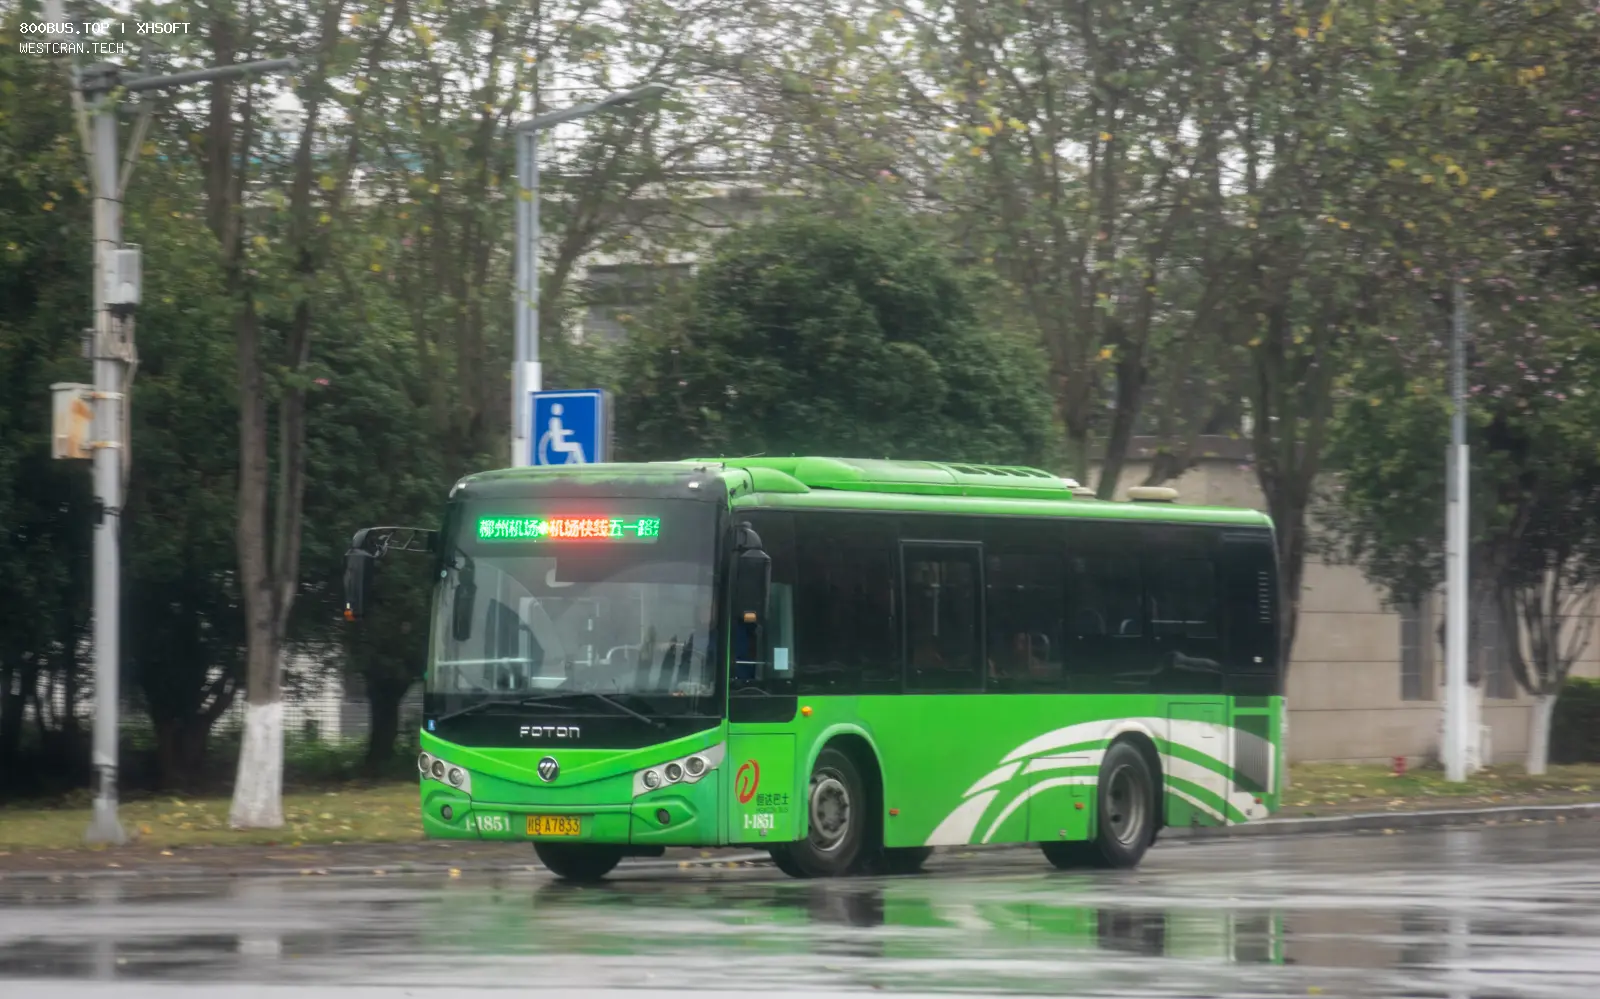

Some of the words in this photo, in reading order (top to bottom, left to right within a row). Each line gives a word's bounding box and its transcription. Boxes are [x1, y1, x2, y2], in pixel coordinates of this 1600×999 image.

[519, 726, 580, 739] FOTON
[465, 815, 511, 832] 1-1851
[743, 813, 775, 829] 1-1851
